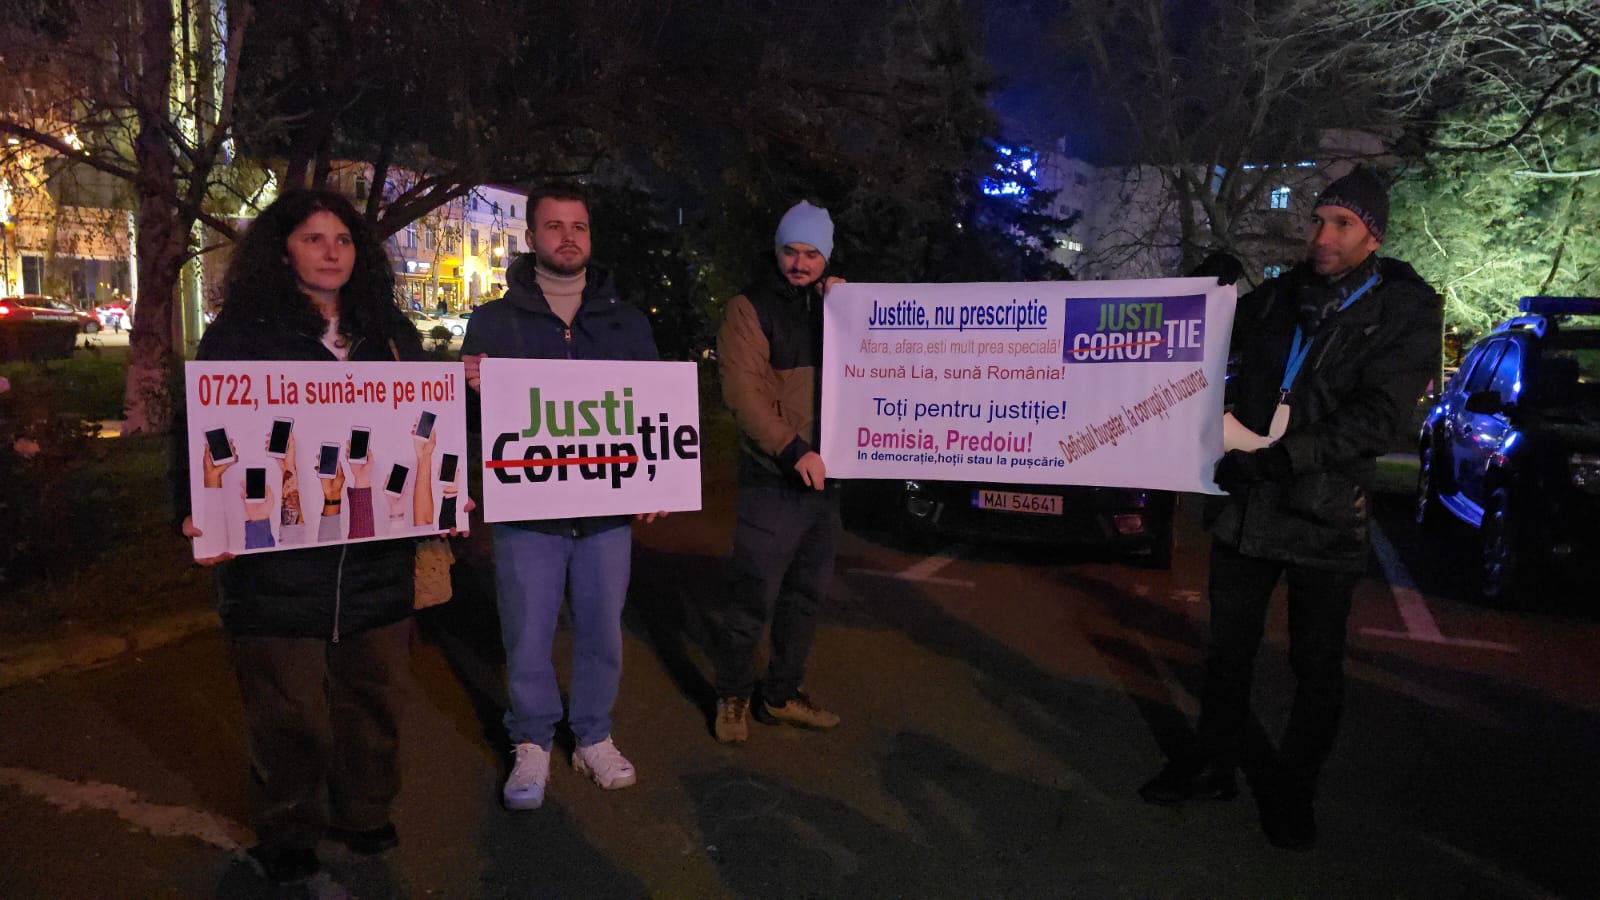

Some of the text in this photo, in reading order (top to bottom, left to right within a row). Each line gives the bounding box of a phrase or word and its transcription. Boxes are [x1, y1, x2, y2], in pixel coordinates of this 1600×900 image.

[868, 298, 1048, 332] Justitie, nu prescriptie
[1096, 302, 1164, 332] JUSTI
[859, 338, 892, 356] Afara,
[950, 338, 975, 354] mult
[978, 342, 1004, 357] prea
[844, 364, 1066, 381] Nu sună Lia, sună România!
[198, 373, 456, 411] 0722, Lia sună-ne pe noi!
[521, 387, 635, 438] Justi
[872, 397, 1067, 425] Toți pentru justiție!
[1058, 425, 1098, 464] Deficitul
[1090, 413, 1133, 447] bugetar,
[1120, 405, 1139, 428] la
[1167, 367, 1209, 402] buzunar
[857, 427, 1033, 454] Demisia, Predoiu!
[857, 450, 868, 460] In
[967, 453, 993, 466] stau
[996, 453, 1007, 465] la
[1010, 455, 1066, 469] pușcărie
[984, 493, 1056, 513] MAI 54641
